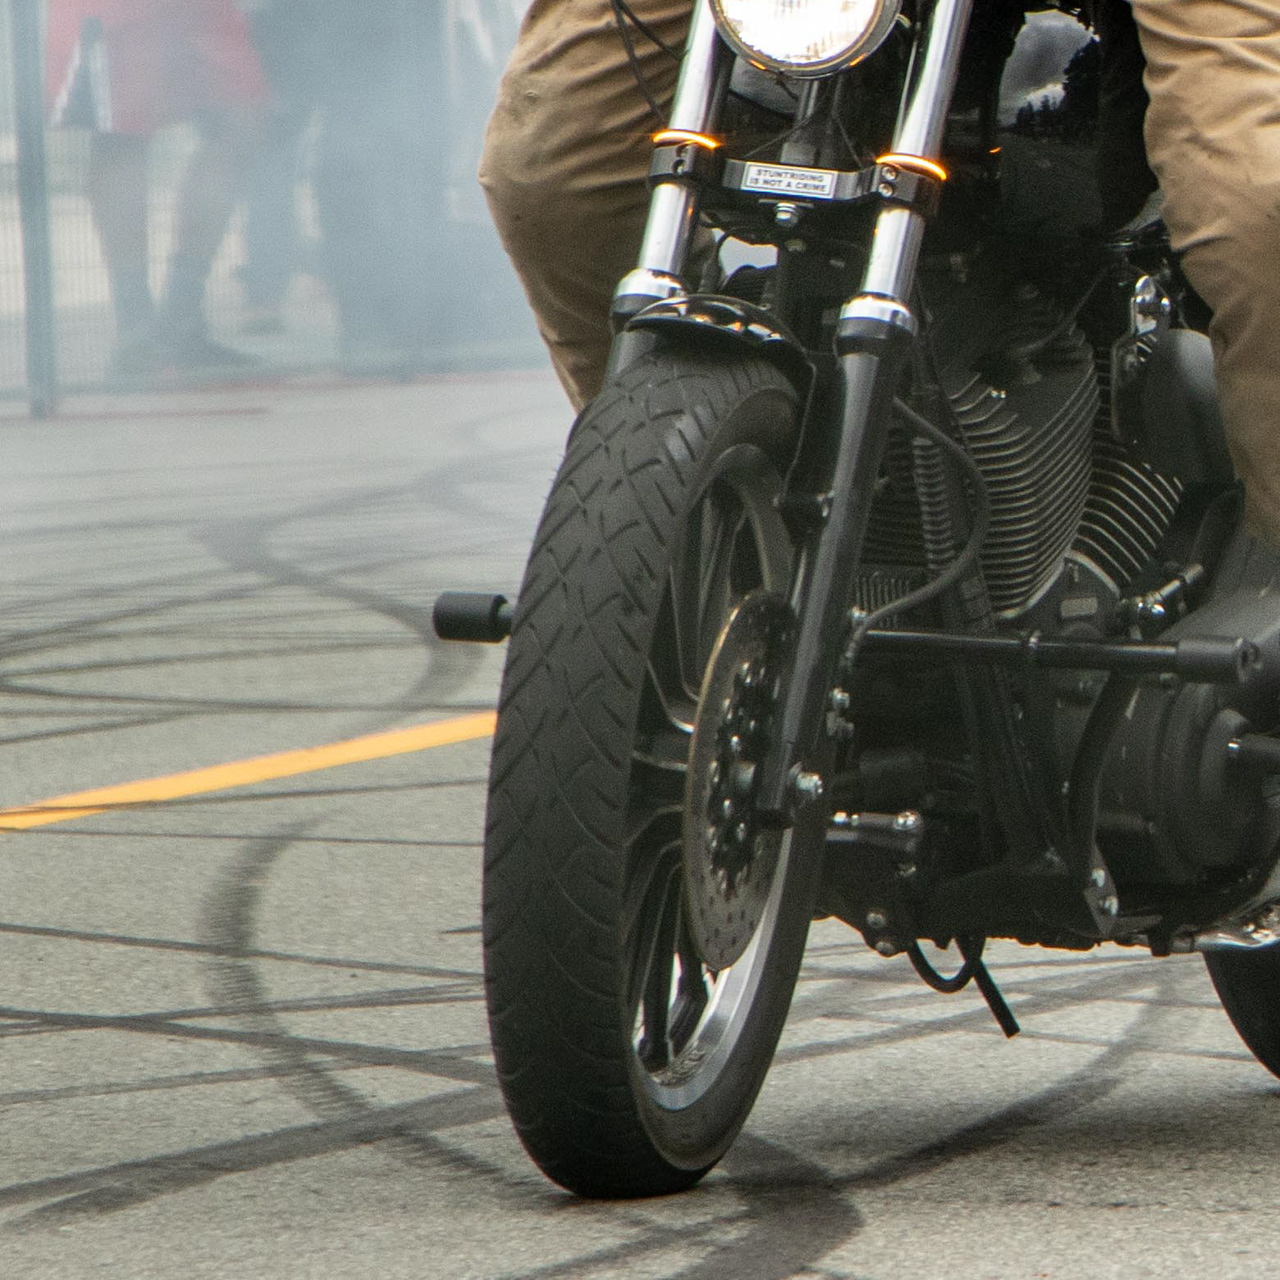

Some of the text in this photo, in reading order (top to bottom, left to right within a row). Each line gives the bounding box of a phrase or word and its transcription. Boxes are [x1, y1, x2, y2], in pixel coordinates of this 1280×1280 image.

[756, 168, 825, 183] STUNTRIDING
[762, 178, 784, 187] NOT
[794, 181, 827, 192] CRIME
